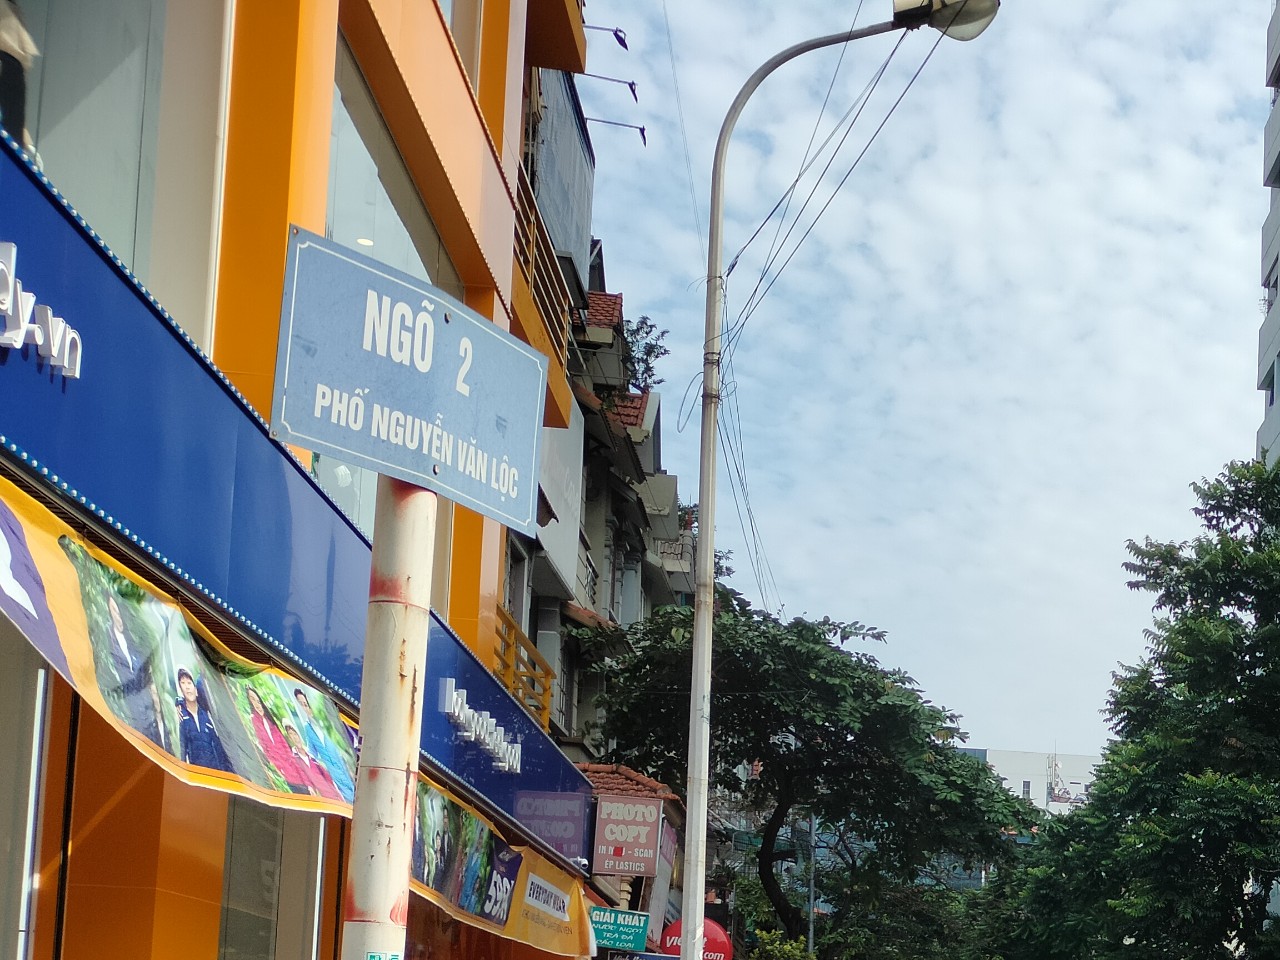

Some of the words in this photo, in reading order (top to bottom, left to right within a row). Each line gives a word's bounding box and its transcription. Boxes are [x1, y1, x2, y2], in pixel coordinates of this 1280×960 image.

[363, 289, 435, 373] NGÕ
[455, 336, 473, 397] 2
[314, 383, 370, 431] PHỐ
[371, 403, 454, 466] NGUYỄN
[457, 436, 488, 484] VĂN
[490, 454, 519, 502] LỘC
[600, 801, 657, 822] PHOTO
[604, 823, 651, 843] COPY
[598, 845, 606, 854] IN
[634, 848, 653, 858] SCAN
[615, 861, 645, 872] LASTICS
[592, 909, 615, 924] GIẢI
[616, 912, 646, 927] KHÁT
